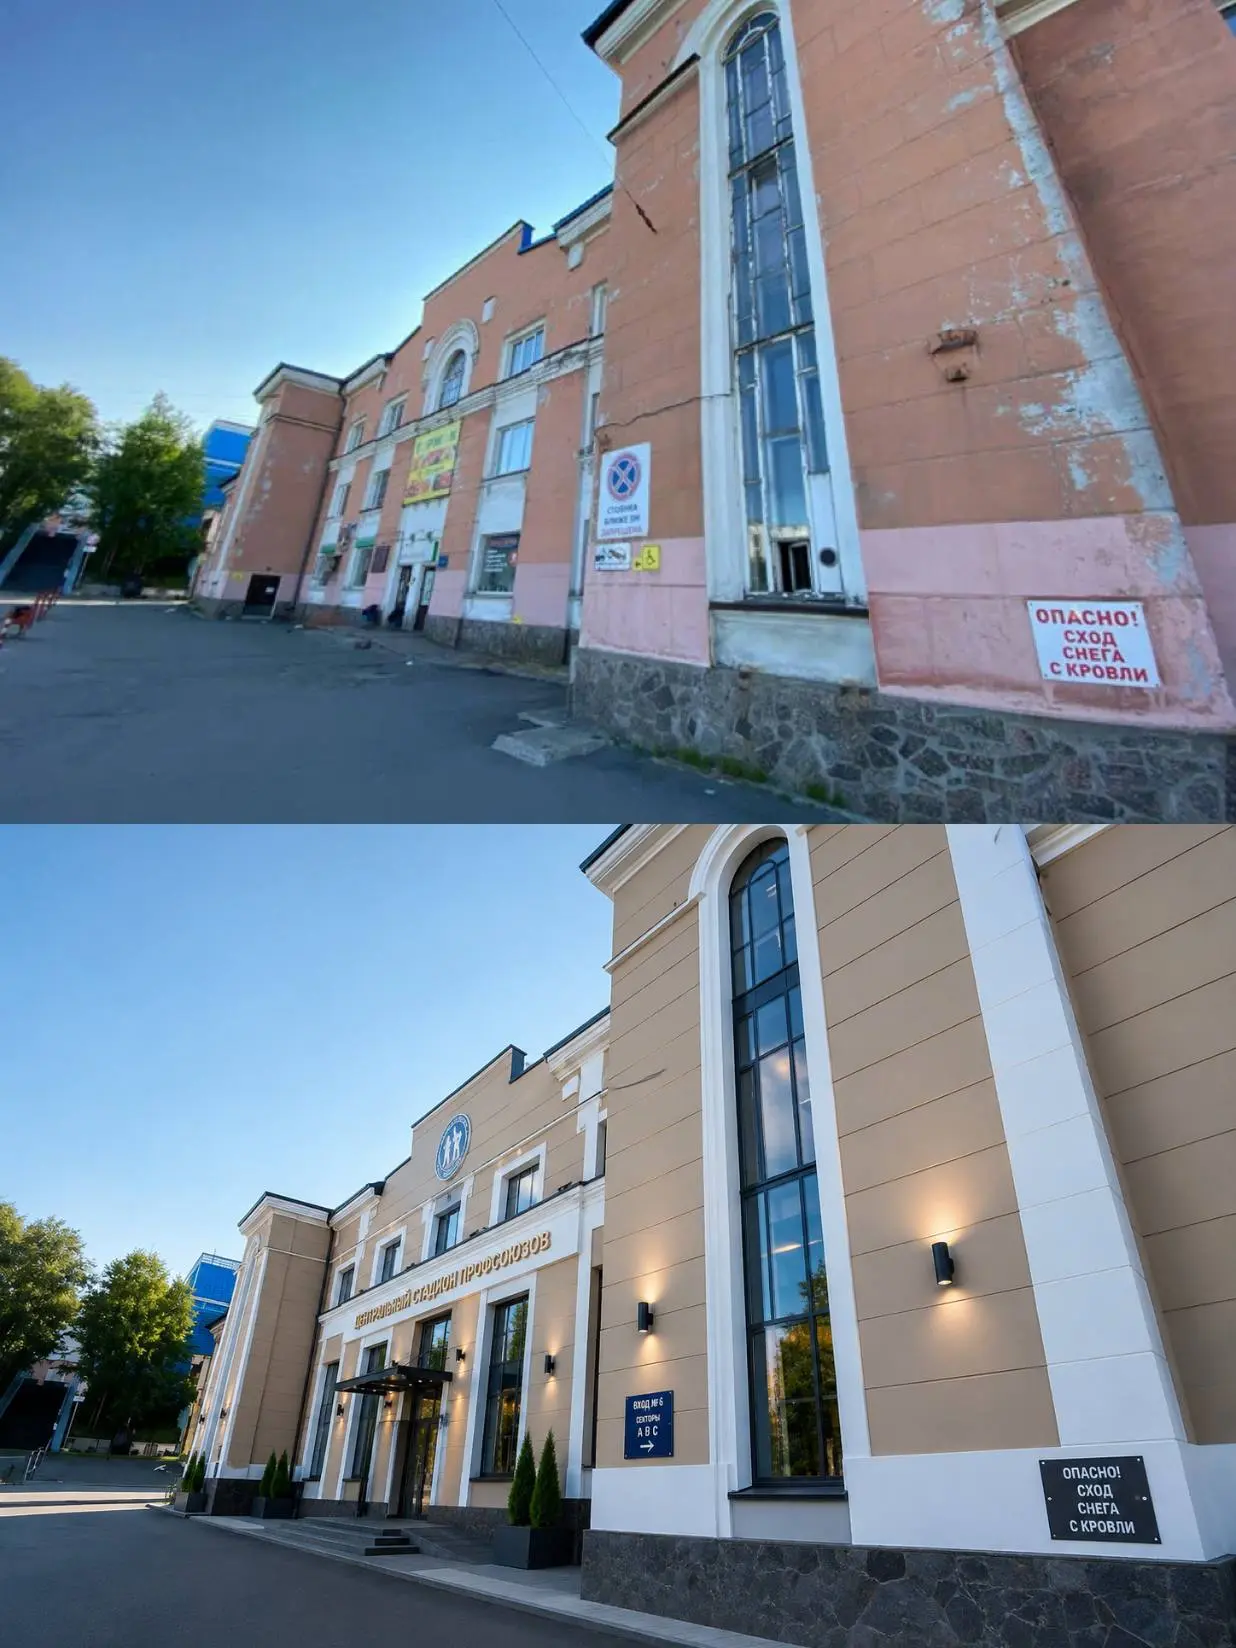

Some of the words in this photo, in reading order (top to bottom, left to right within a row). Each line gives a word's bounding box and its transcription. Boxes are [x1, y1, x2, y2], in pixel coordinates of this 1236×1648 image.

[1036, 608, 1139, 627] ОПАСНО!
[1063, 630, 1117, 648] СХОД
[1062, 646, 1125, 663] СНЕГА
[1050, 662, 1062, 675] С
[1066, 663, 1149, 683] КРОВЛИ
[633, 1400, 650, 1411] ВХОД
[636, 1414, 661, 1424] СЕКТОРЫ
[1062, 1466, 1121, 1479] ОПАСНО!
[1077, 1484, 1114, 1499] СХОД
[1077, 1502, 1120, 1515] СНЕГА
[1069, 1520, 1079, 1532] С
[1080, 1520, 1136, 1534] КРОВЛИ
